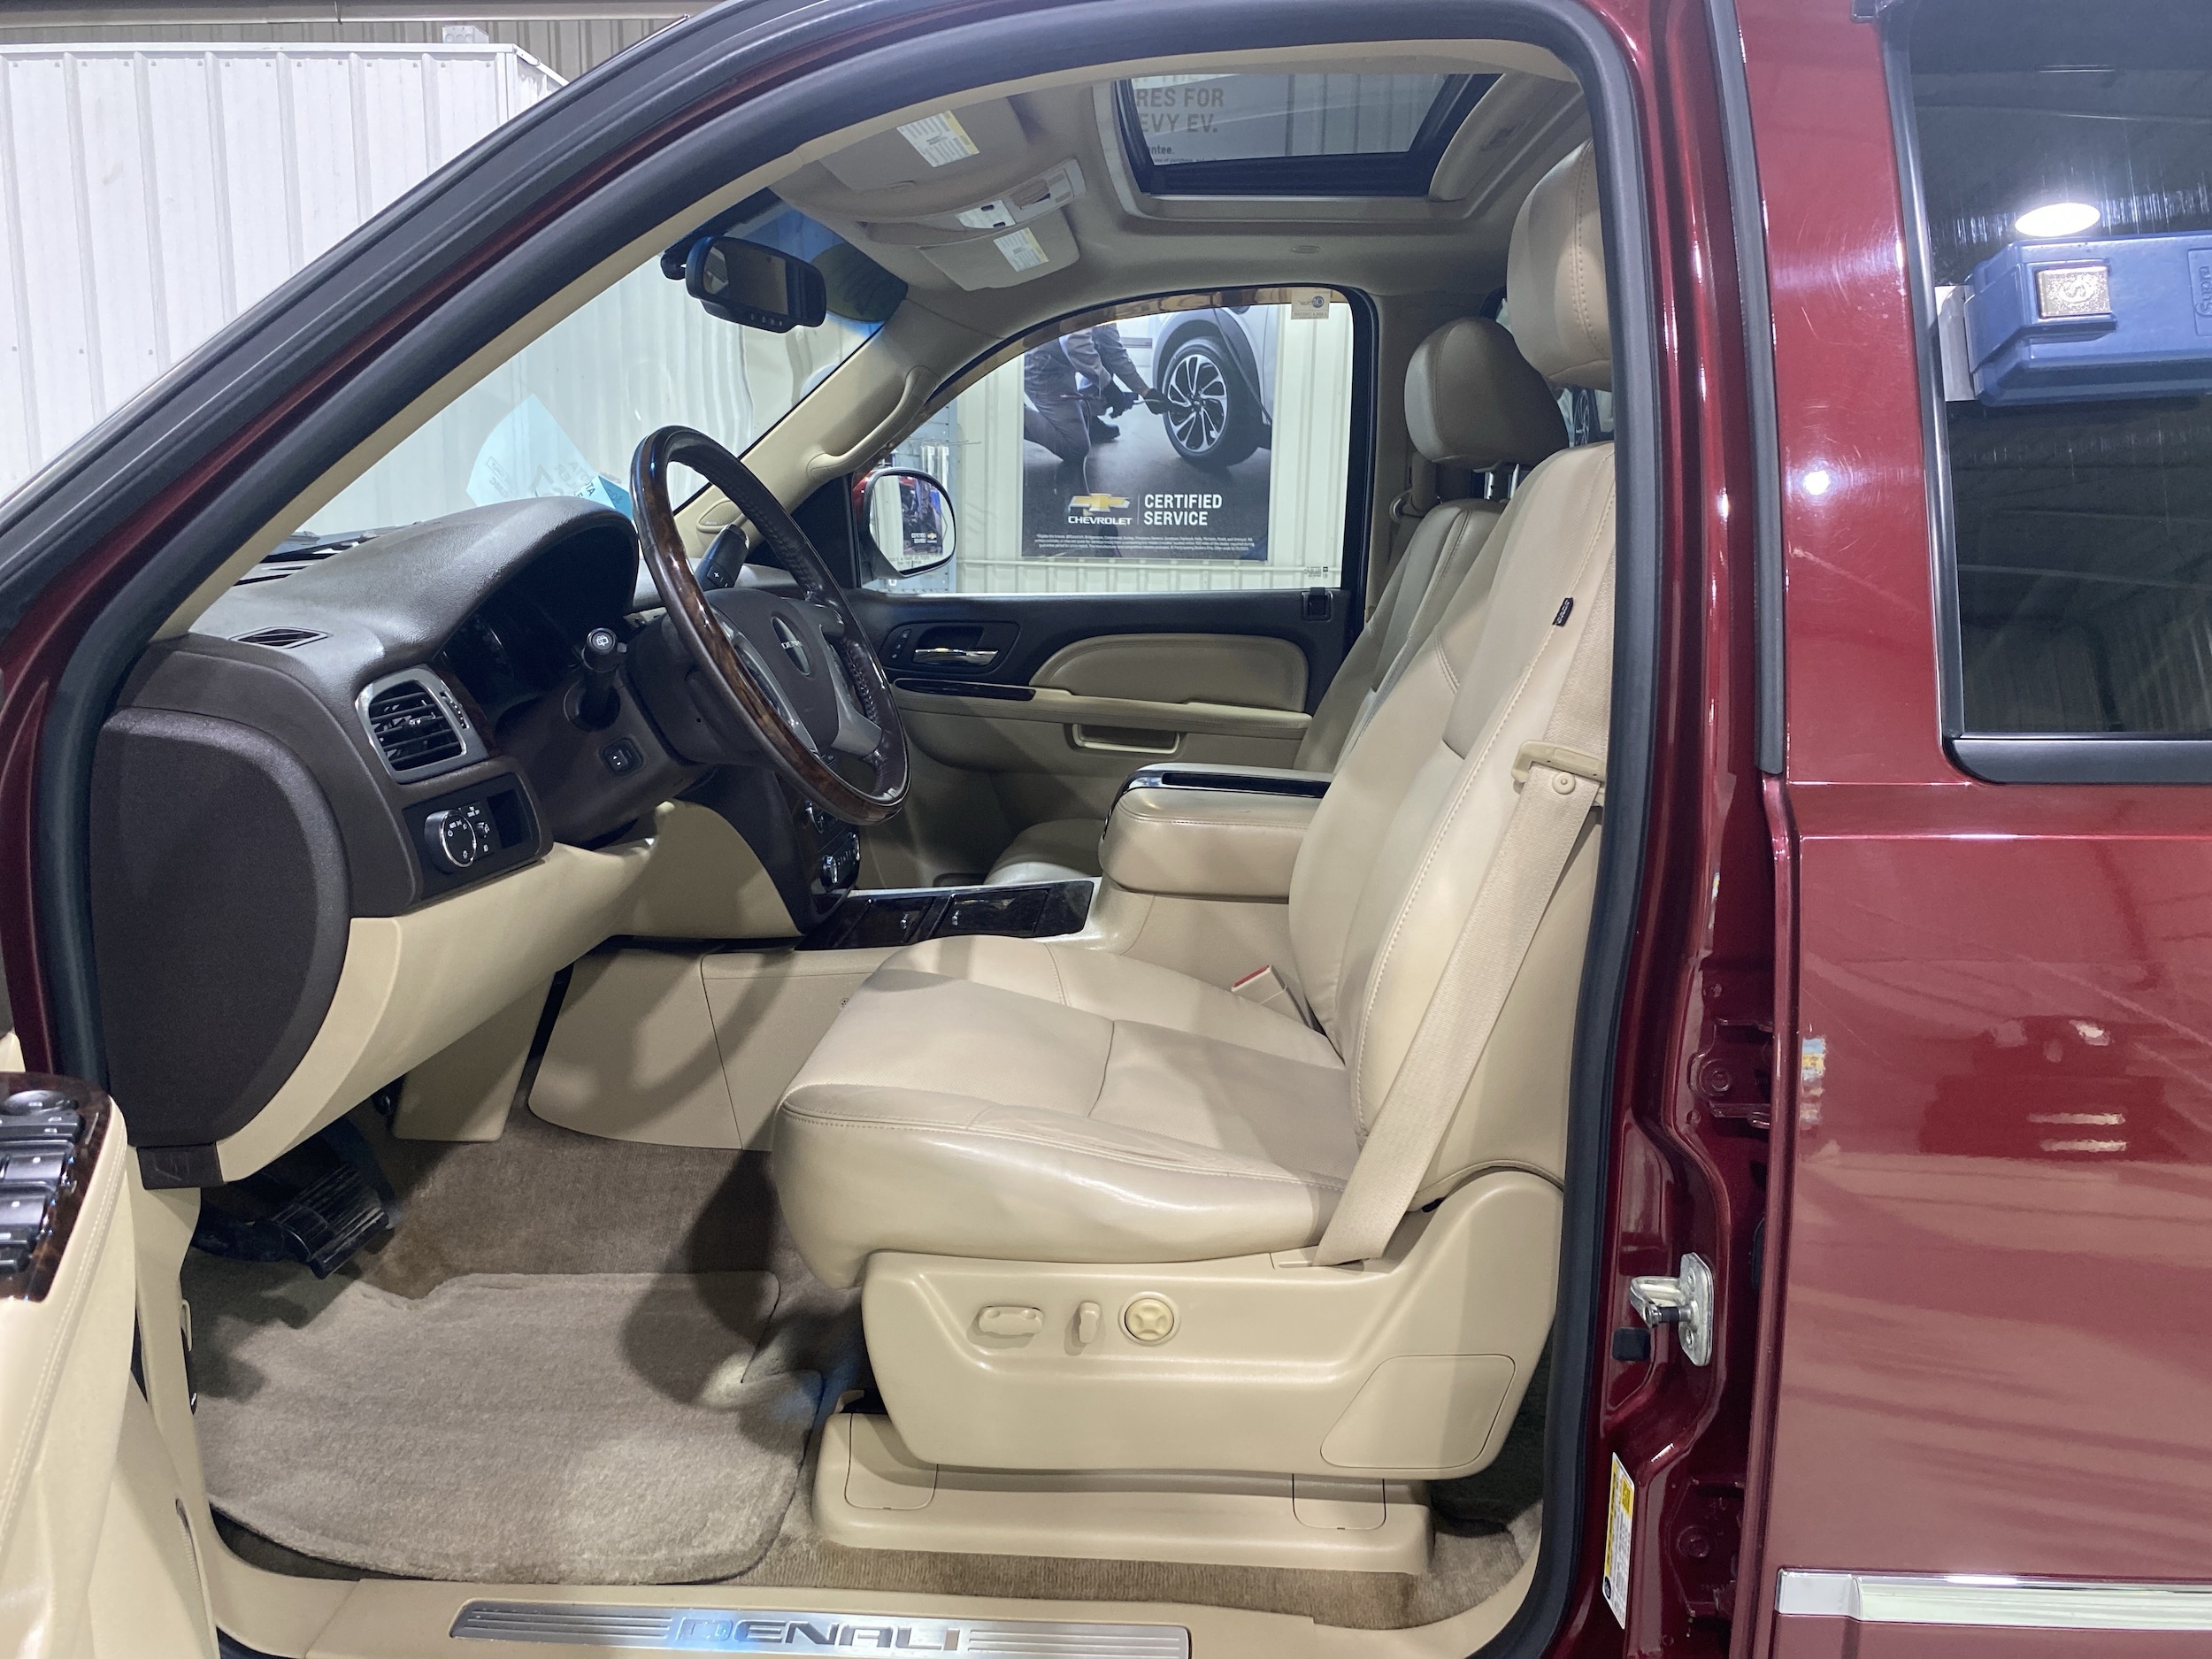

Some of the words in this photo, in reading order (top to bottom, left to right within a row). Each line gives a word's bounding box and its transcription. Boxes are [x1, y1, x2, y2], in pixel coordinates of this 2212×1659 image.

[1184, 88, 1225, 107] FOR
[1187, 113, 1218, 133] EV.
[1144, 494, 1223, 509] CERTIFIED
[1068, 516, 1133, 526] CHEVROLET
[1143, 511, 1209, 526] SERVICE
[676, 1617, 961, 1651] DENALI
